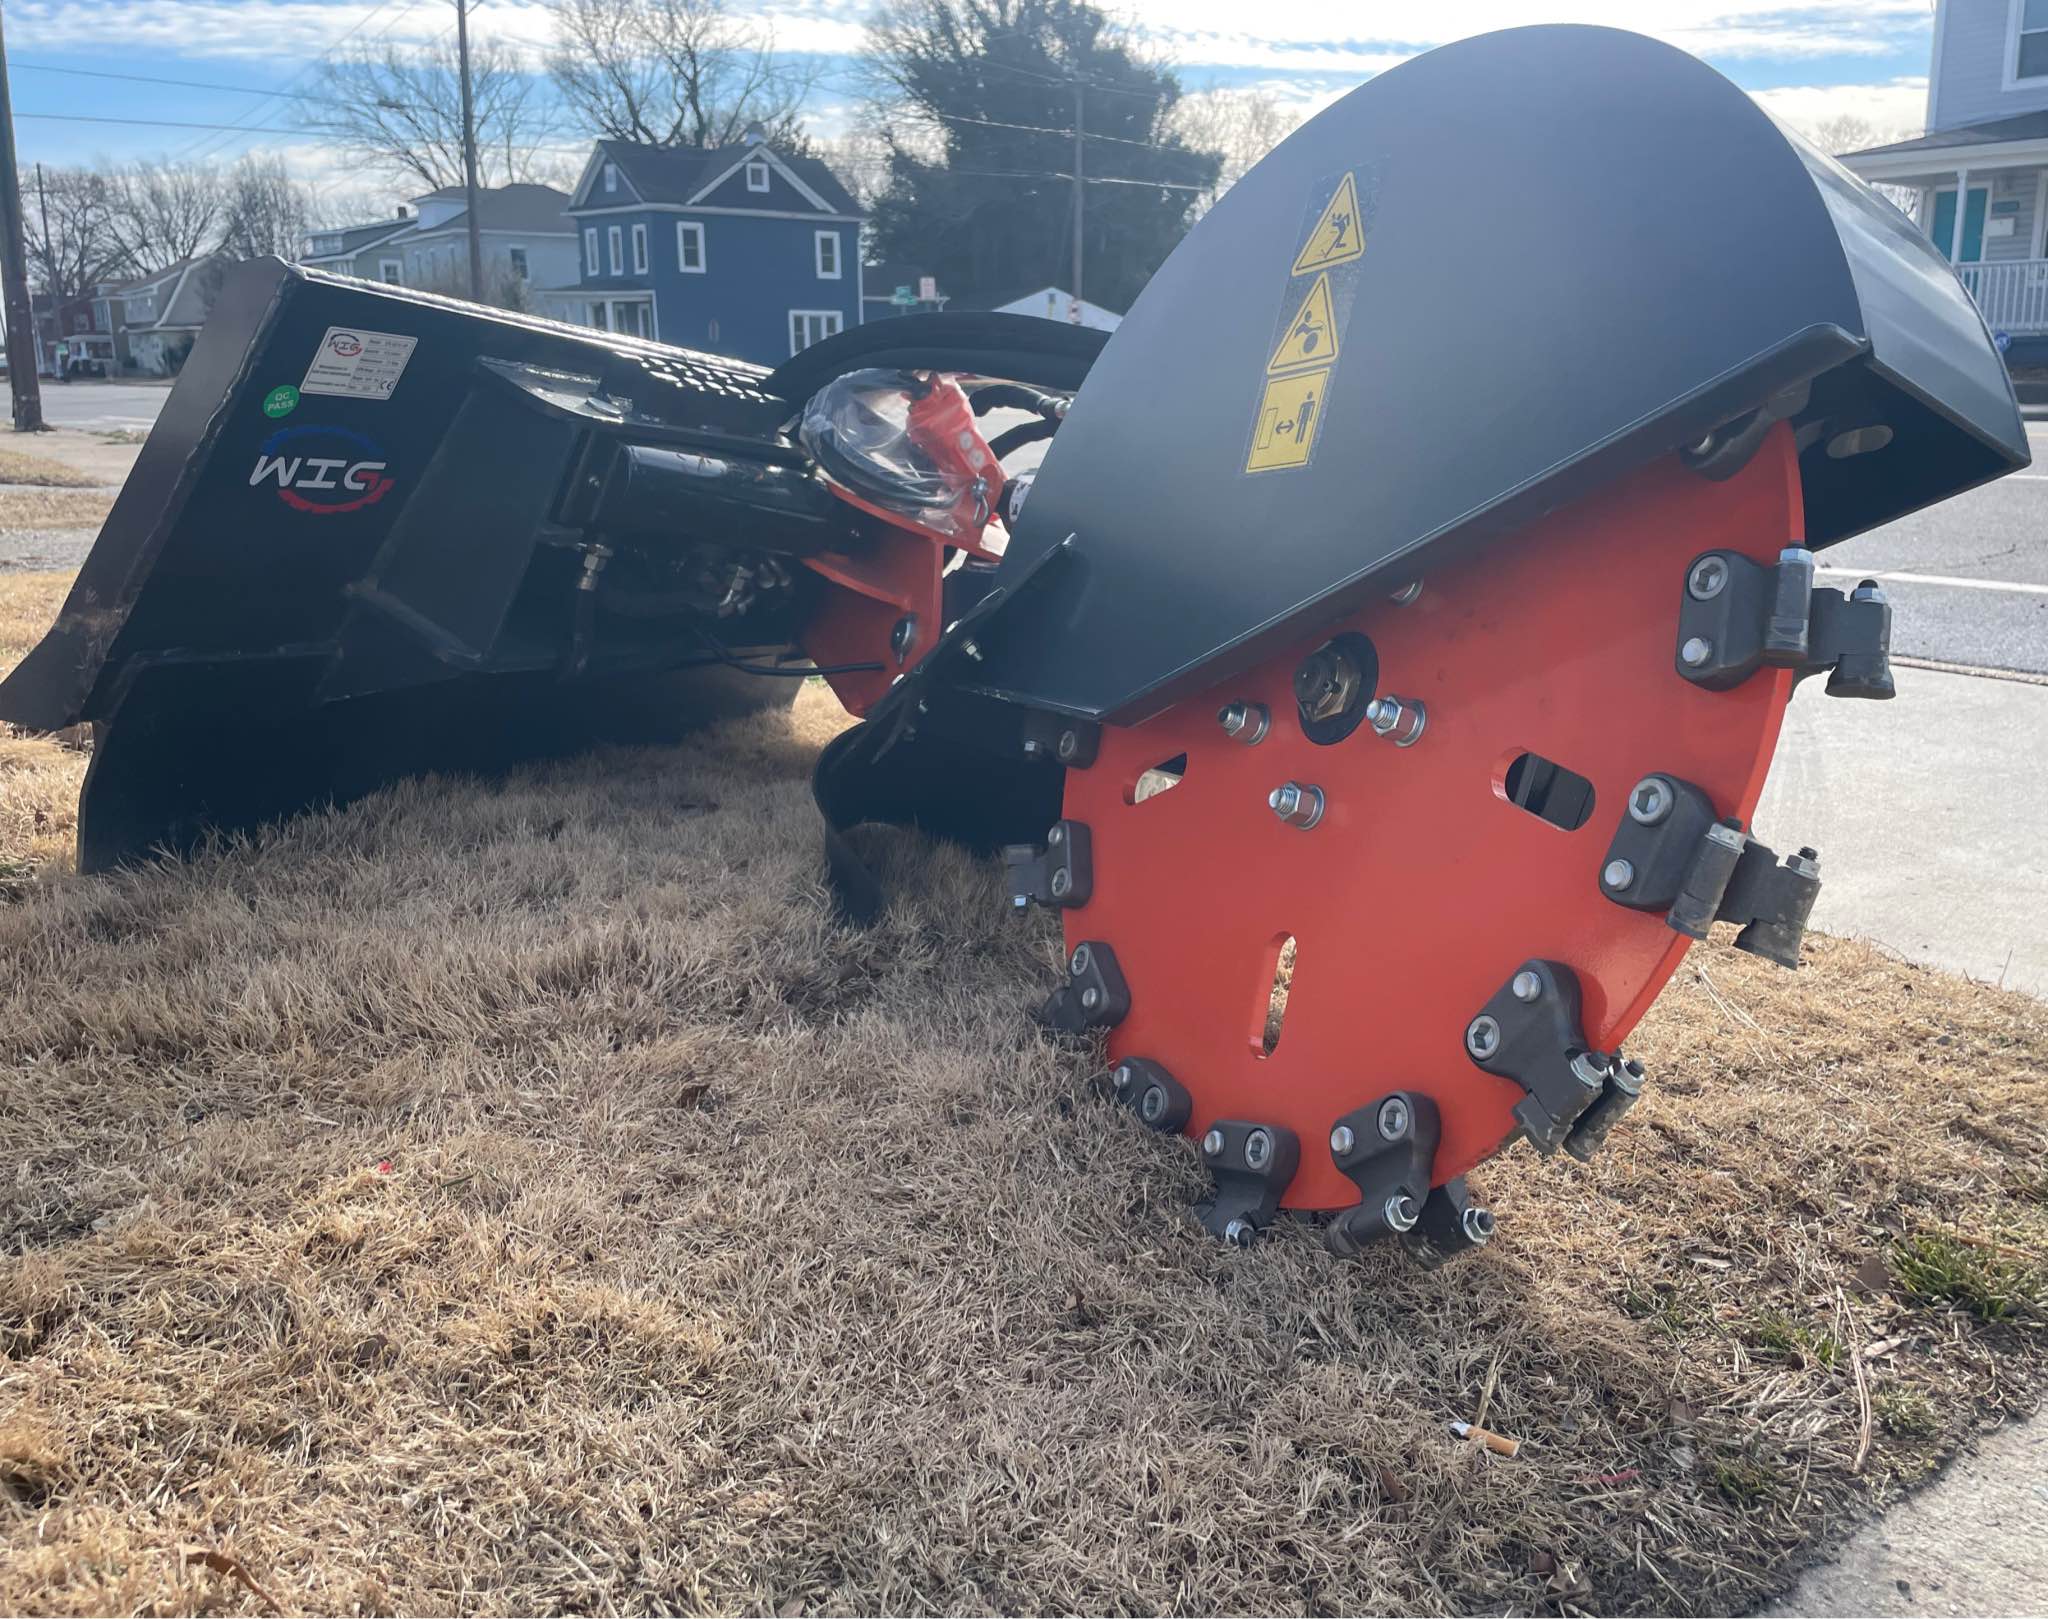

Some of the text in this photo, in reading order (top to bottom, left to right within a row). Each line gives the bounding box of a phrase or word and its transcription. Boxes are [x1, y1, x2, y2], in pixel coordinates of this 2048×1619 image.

[275, 391, 290, 401] QC
[267, 401, 294, 411] PASS
[249, 455, 390, 490] WIG
